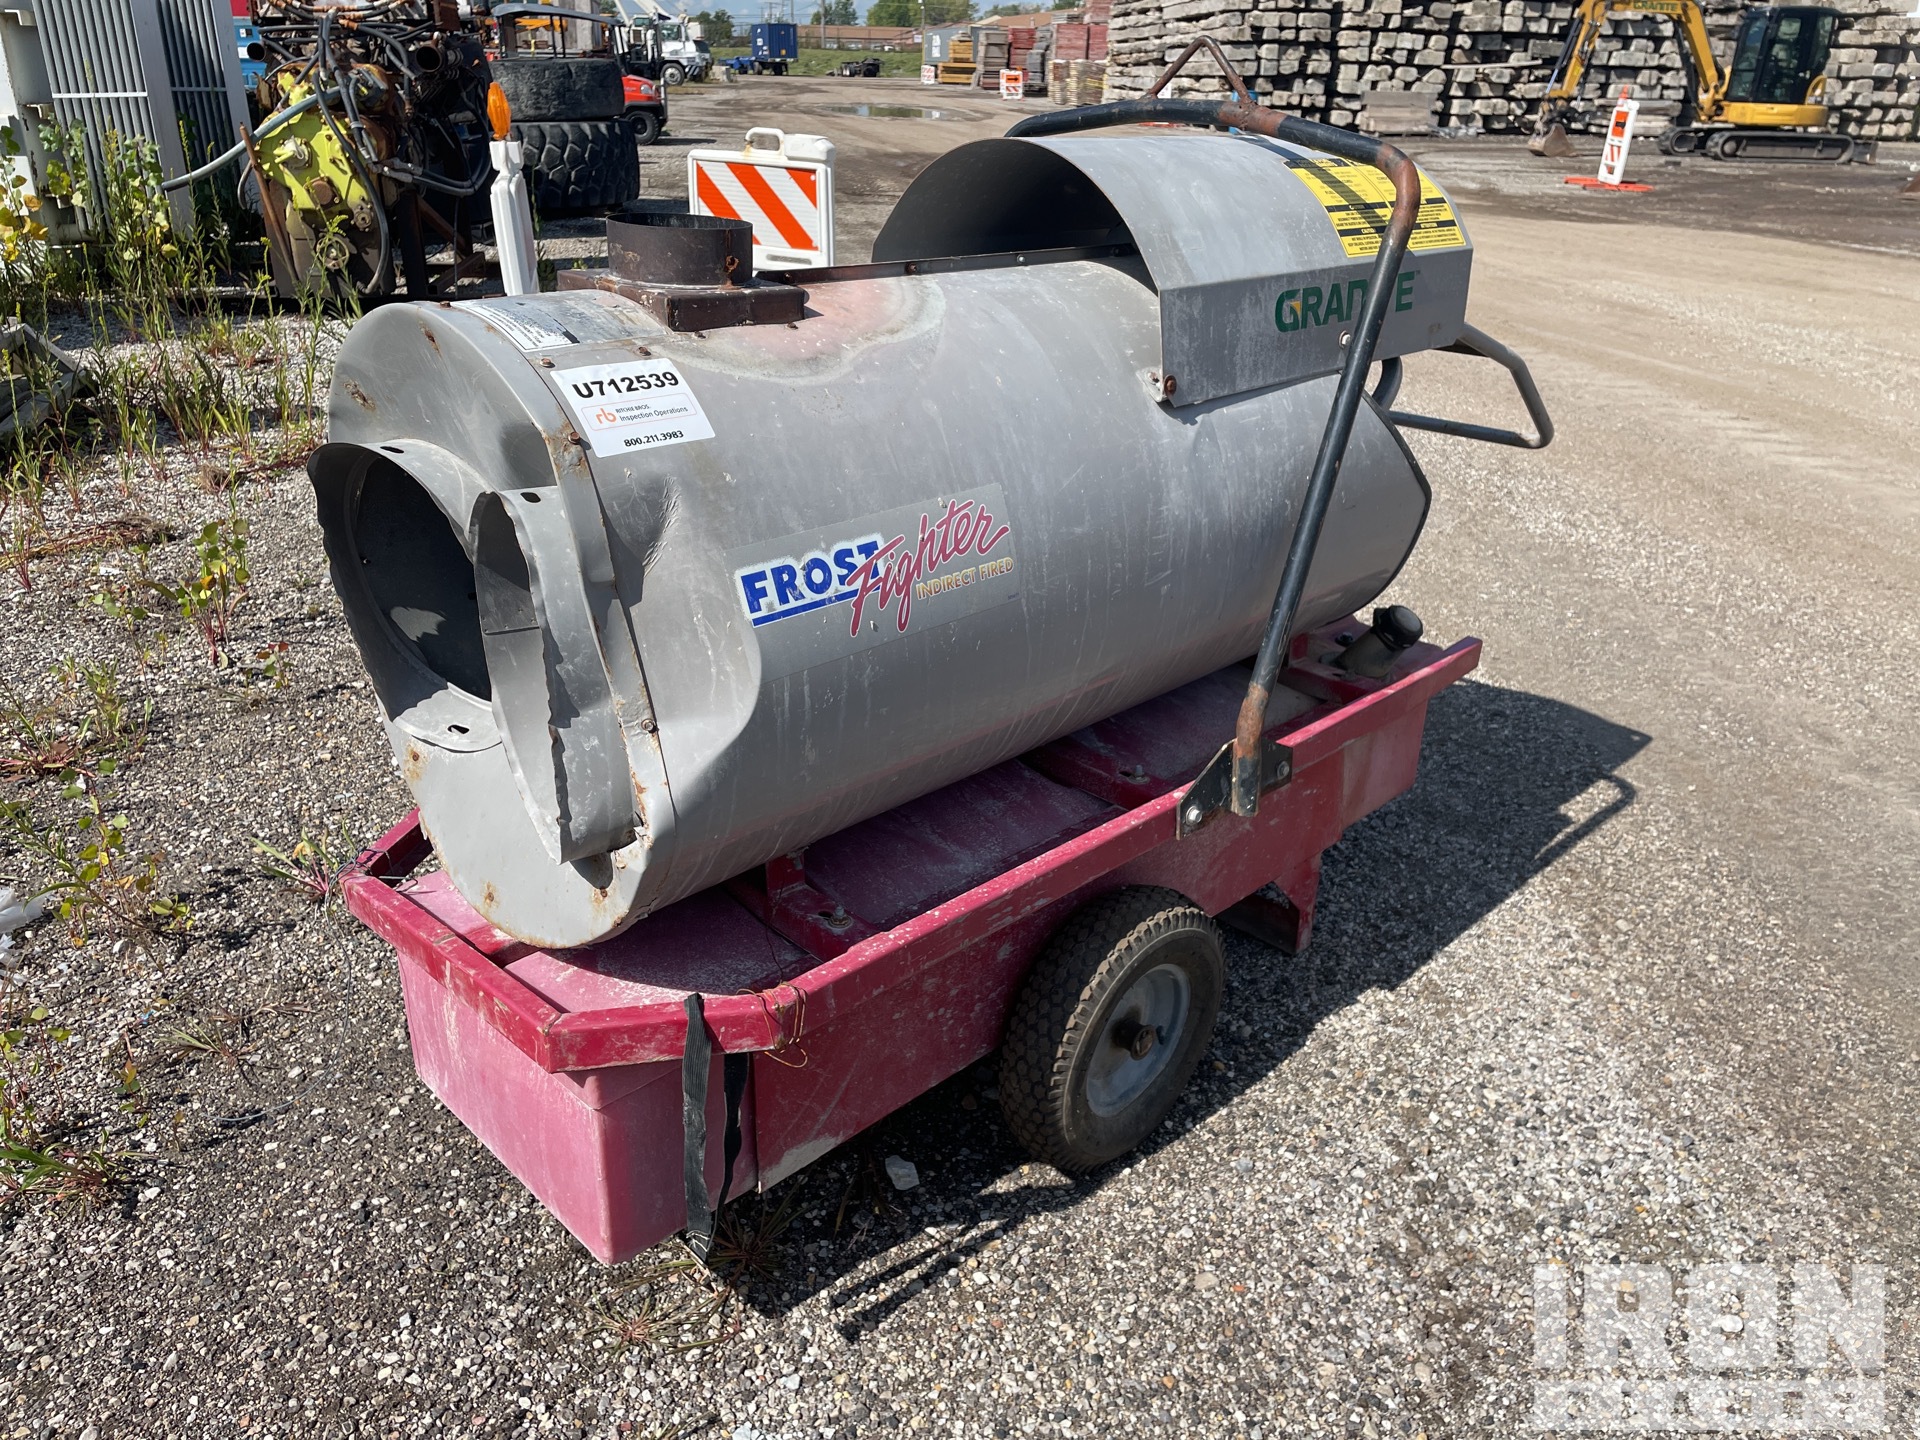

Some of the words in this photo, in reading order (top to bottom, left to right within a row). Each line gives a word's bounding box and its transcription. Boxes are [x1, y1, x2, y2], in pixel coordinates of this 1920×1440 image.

[1275, 270, 1416, 333] GRANE
[571, 371, 679, 398] U712539
[619, 411, 653, 422] Inspection
[654, 406, 689, 417] Operations
[623, 430, 684, 447] 800.211.3983
[741, 540, 881, 614] FROST
[845, 499, 1010, 637] Fighter
[915, 566, 977, 600] INDIRECT
[980, 556, 1014, 581] FIRED
